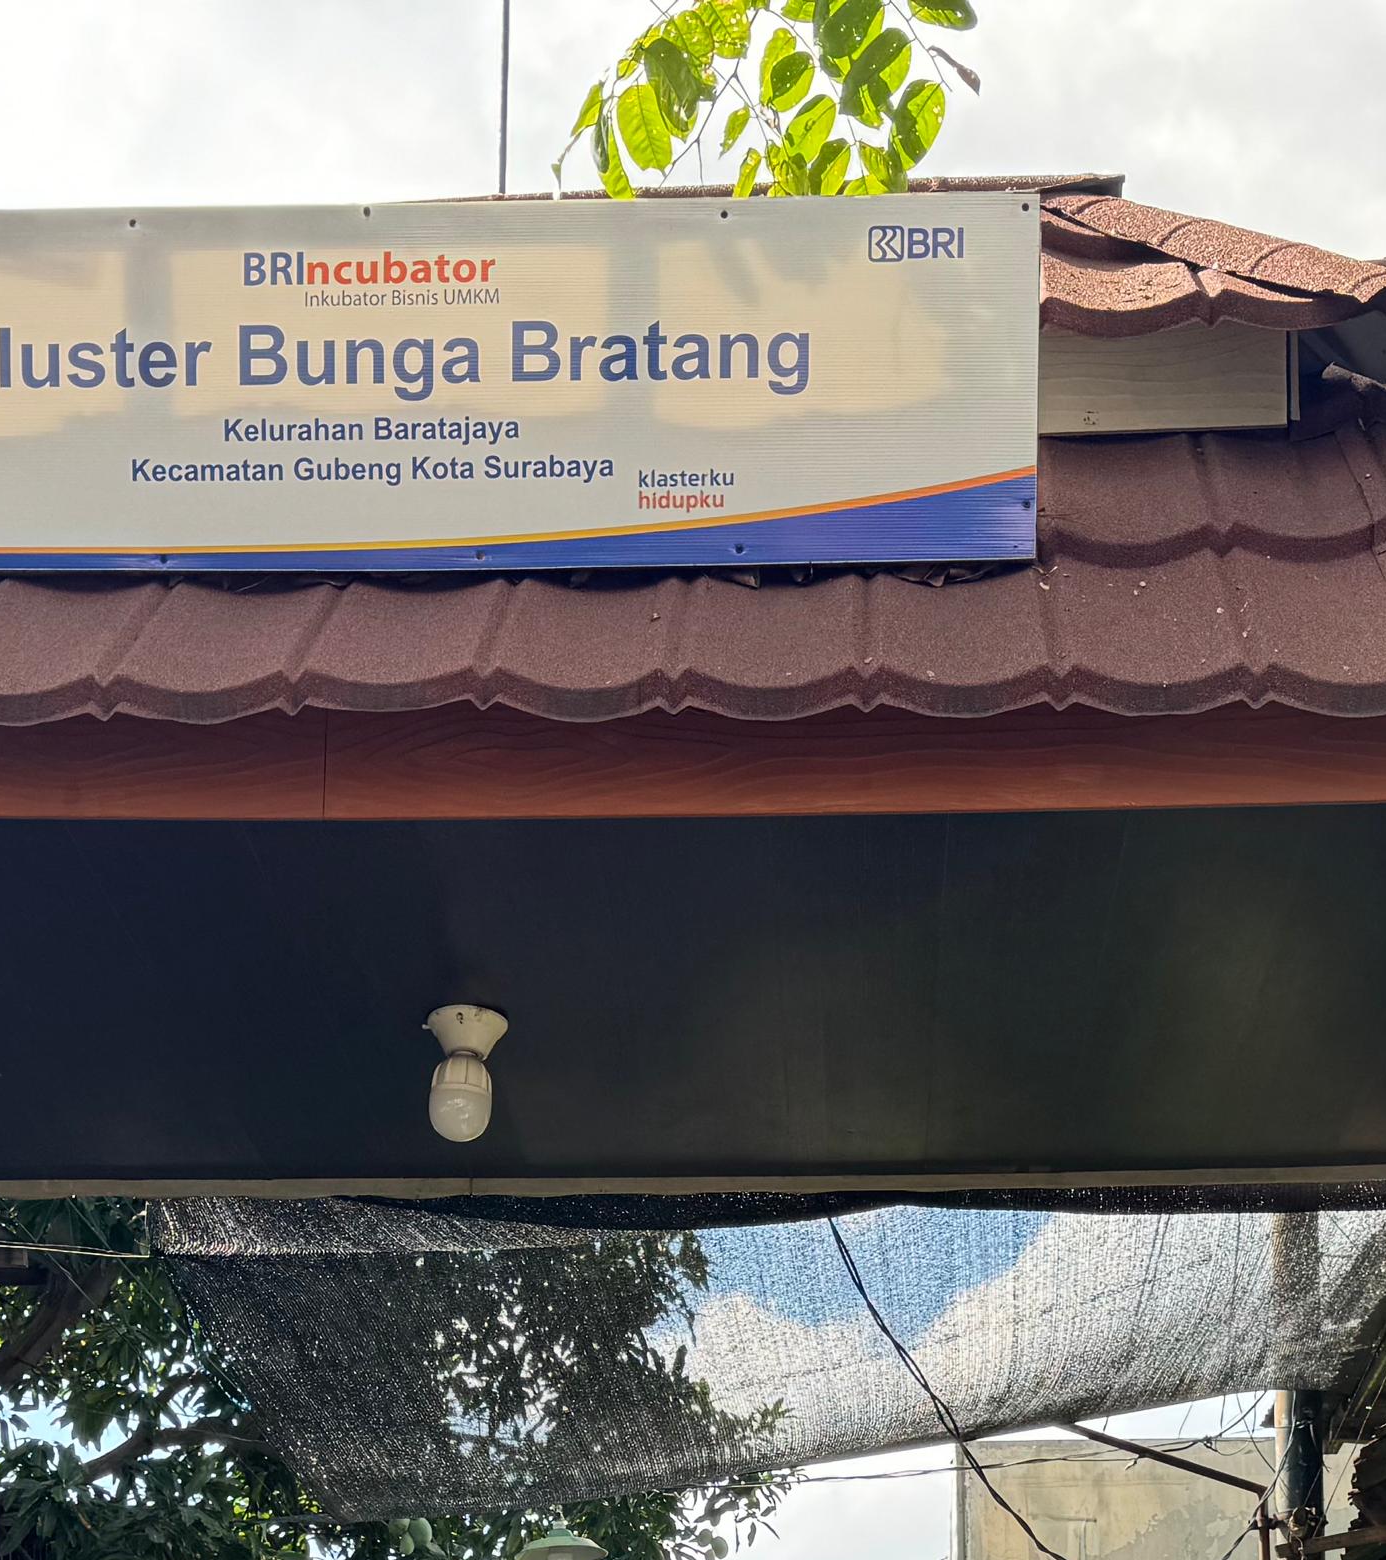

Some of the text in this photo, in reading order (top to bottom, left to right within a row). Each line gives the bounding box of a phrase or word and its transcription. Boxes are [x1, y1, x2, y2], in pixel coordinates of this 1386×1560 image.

[907, 227, 964, 259] BRI
[243, 251, 496, 287] BRIncubator
[304, 287, 501, 308] Inkubator Bisnis UMKM
[238, 323, 481, 402] Bunga
[511, 319, 811, 396] Bratang
[223, 416, 520, 445] Kelurahan Baratajaya
[131, 454, 614, 487] Kecamatan Gubeng Kota Surabaya
[638, 468, 735, 488] klasterku
[638, 490, 725, 512] hidupku
